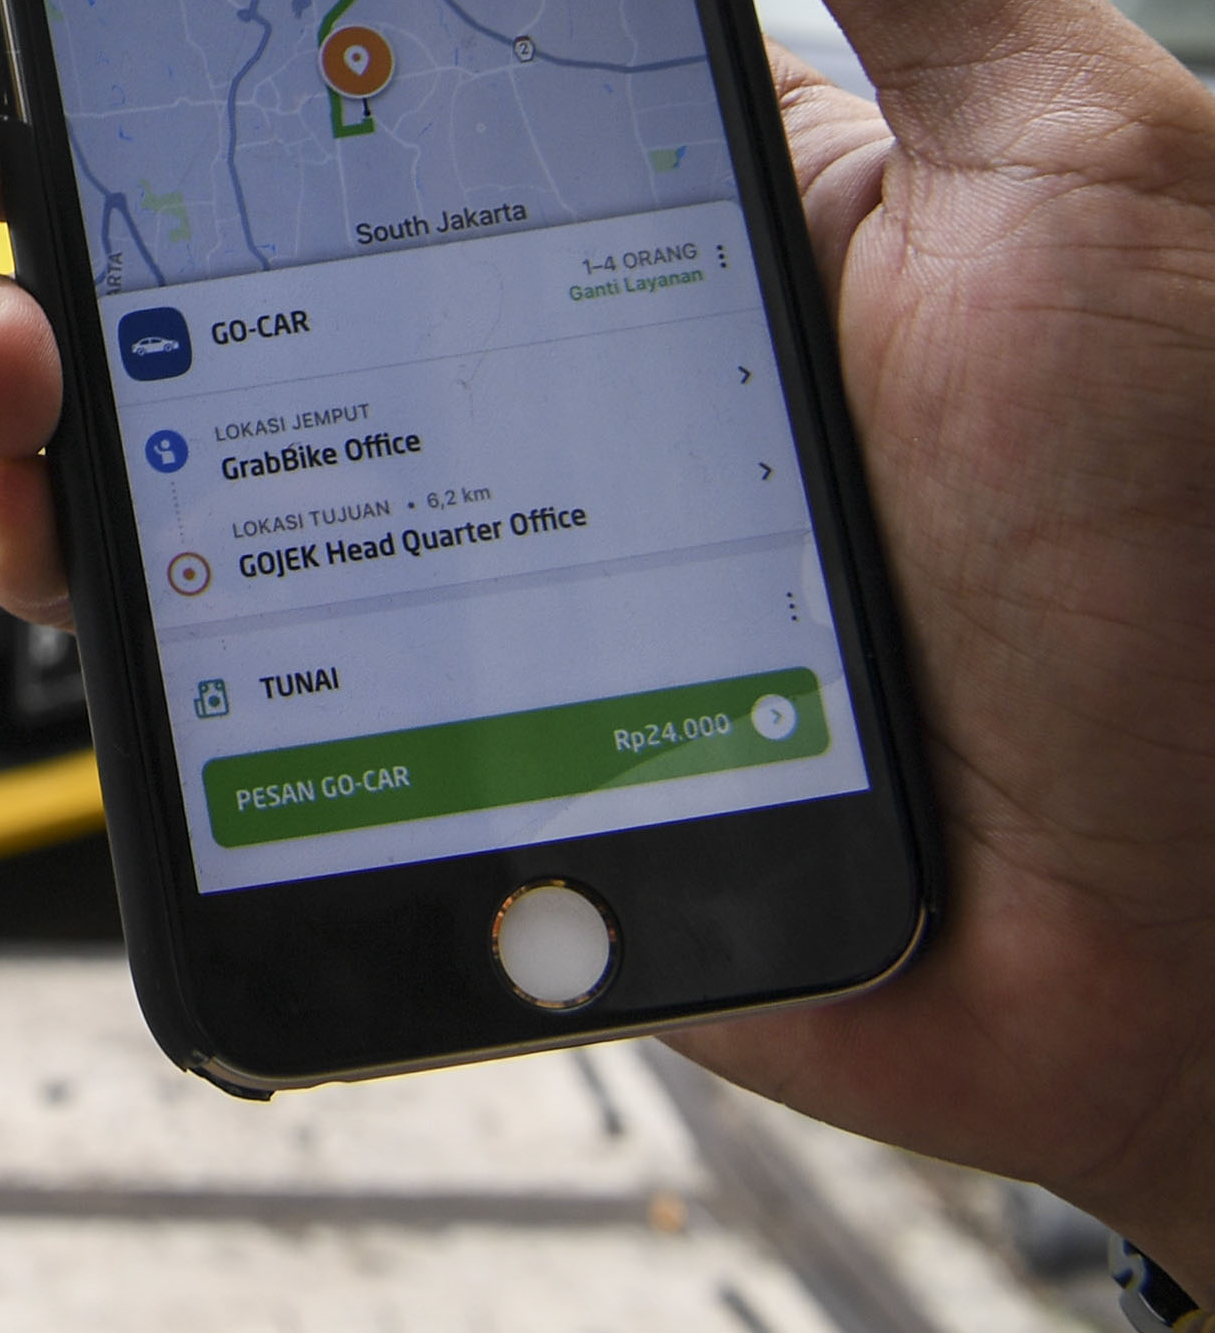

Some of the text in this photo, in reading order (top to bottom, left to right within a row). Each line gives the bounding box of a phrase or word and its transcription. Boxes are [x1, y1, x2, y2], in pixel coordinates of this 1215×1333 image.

[355, 202, 527, 245] South Jakarta
[623, 243, 699, 268] ORANG
[568, 268, 705, 301] Ganti Layanan
[211, 310, 311, 346] GO-CAR
[214, 403, 370, 442] LOKASI JEMPUT
[221, 432, 422, 481] GrabBike Office
[232, 485, 492, 539] LOKASI TUJUAN 6,2 km
[239, 507, 588, 579] GOJEK Head Quarter Office
[259, 667, 340, 700] TUNAI
[613, 713, 733, 753] Rp24.000
[236, 765, 411, 812] PESAN GO-CAR
